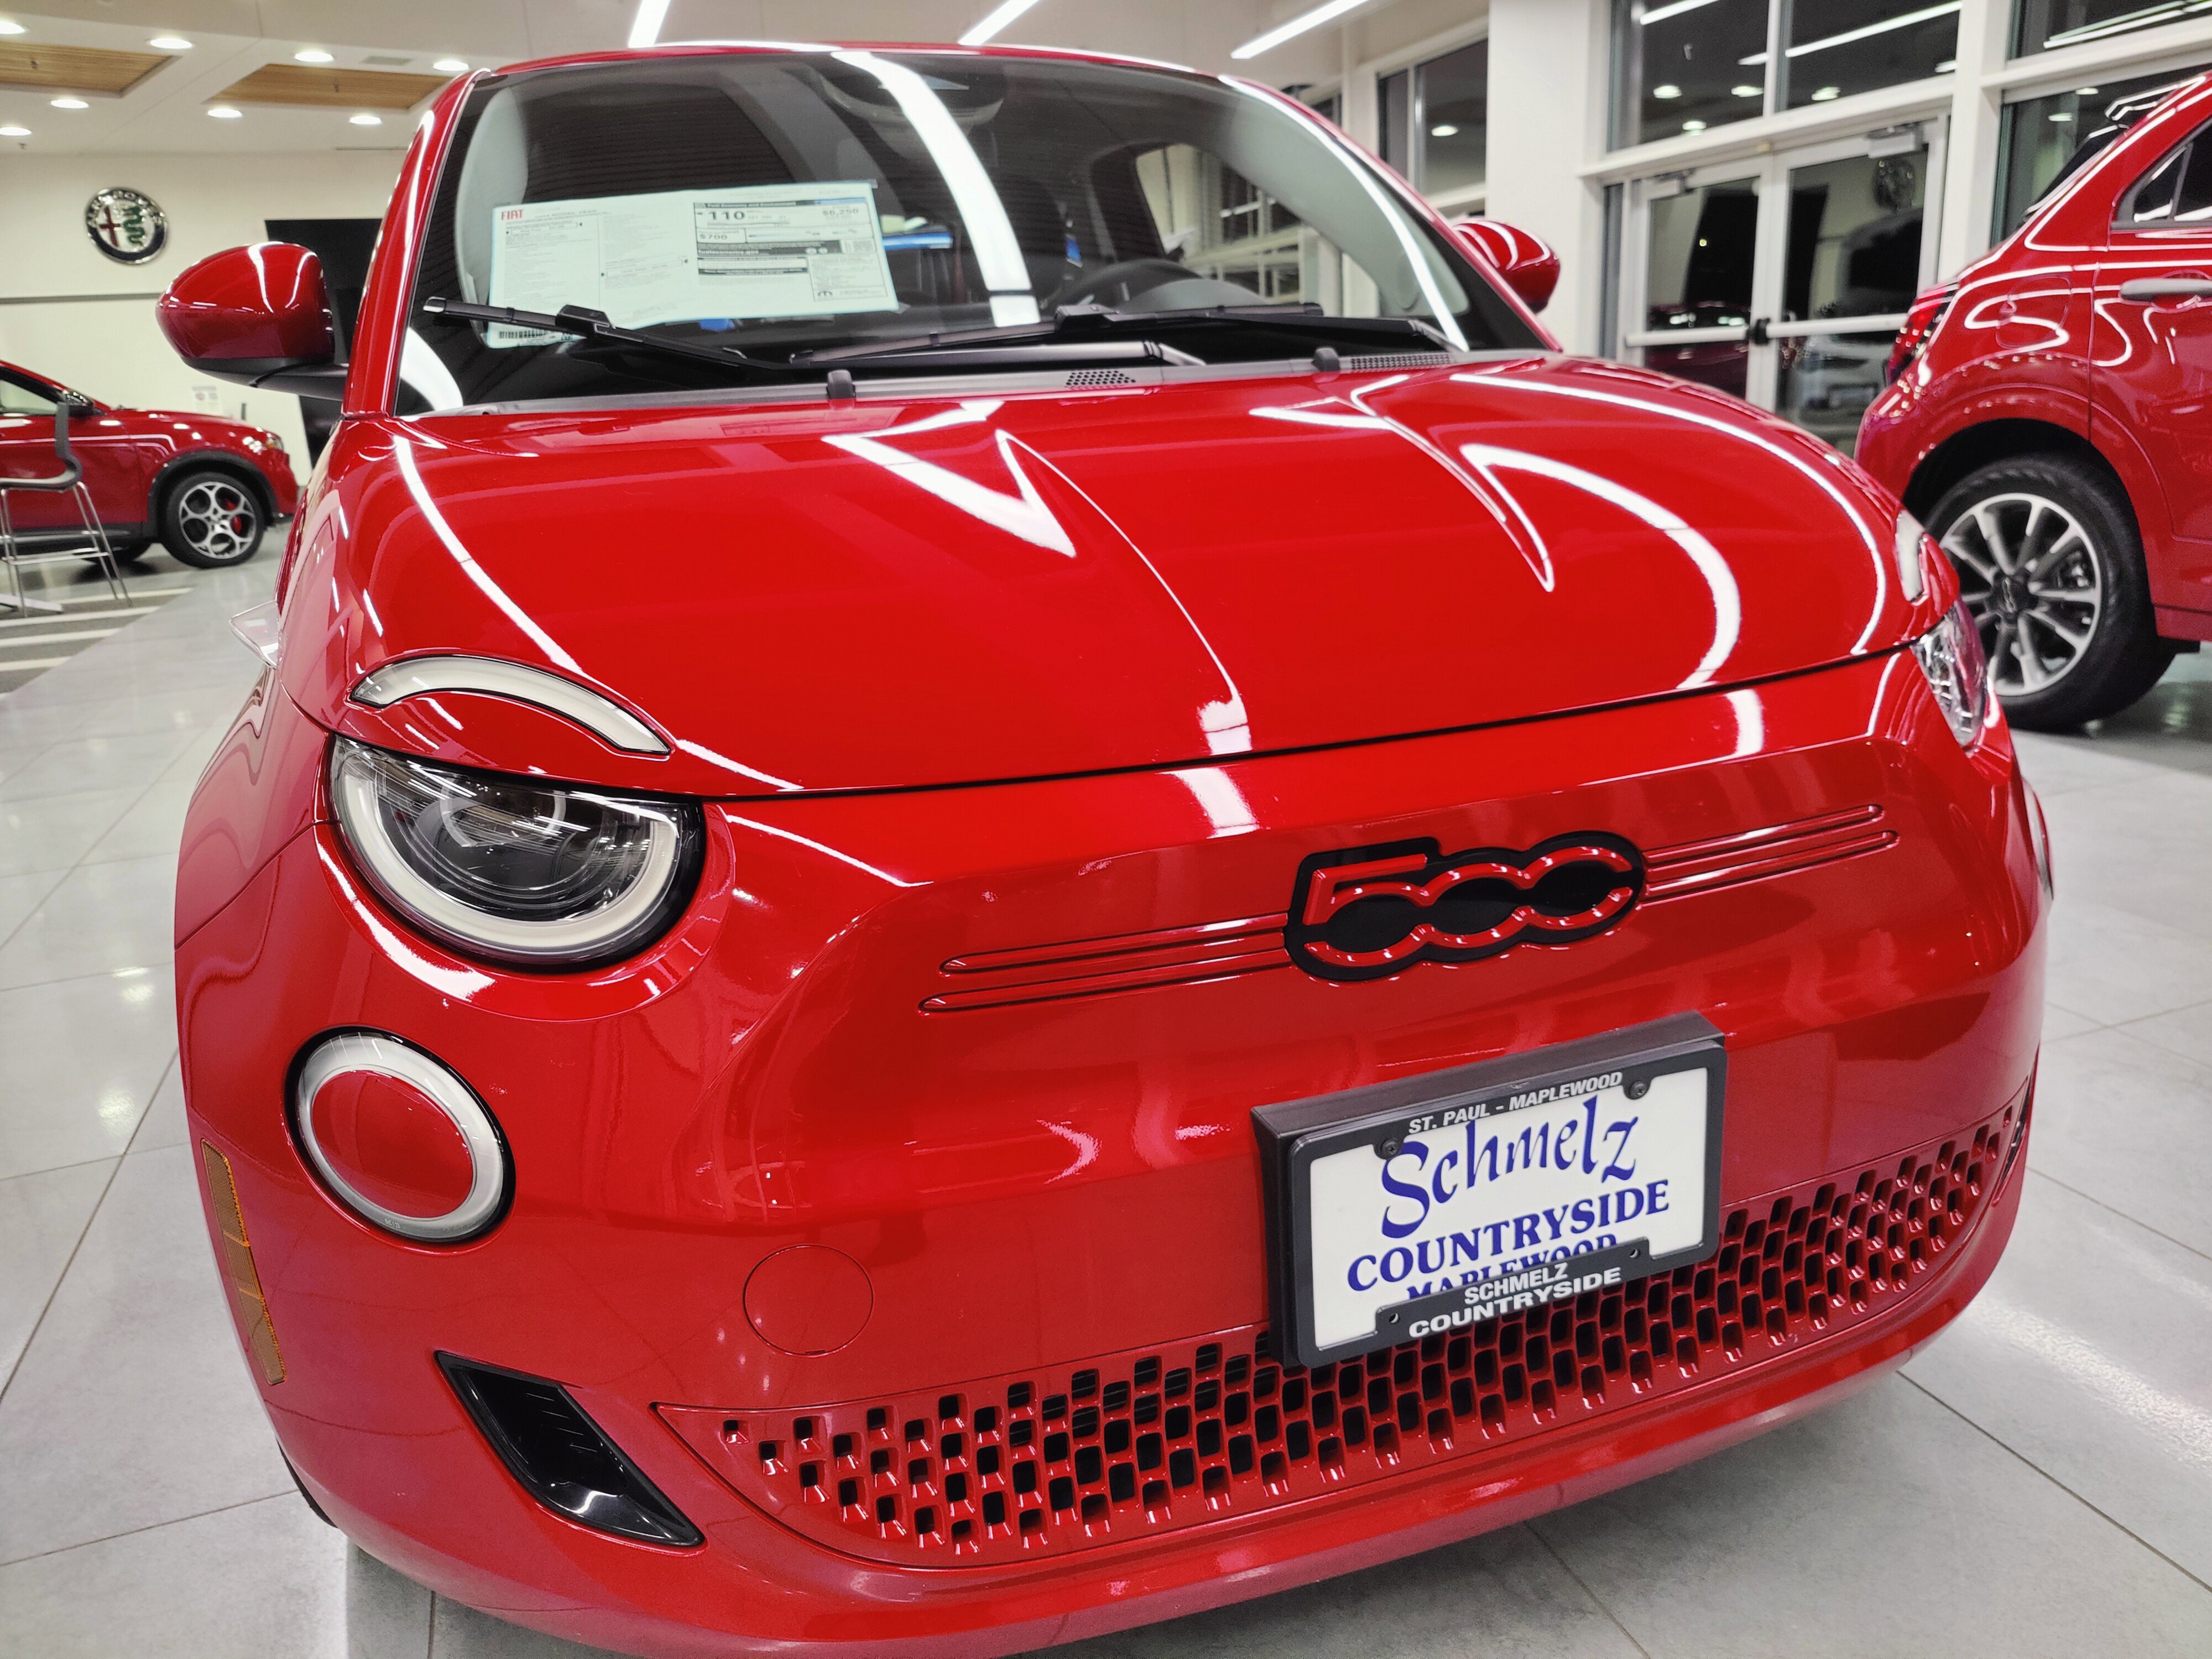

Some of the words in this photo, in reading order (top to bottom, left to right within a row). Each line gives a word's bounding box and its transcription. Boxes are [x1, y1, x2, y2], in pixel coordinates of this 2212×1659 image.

[501, 209, 524, 220] FIAT
[708, 211, 745, 221] 110
[1302, 846, 1634, 968] 500
[1408, 1117, 1437, 1134] ST.
[1443, 1104, 1491, 1127] PAUL
[1508, 1071, 1623, 1111] MAPLEWOOD
[1381, 1094, 1639, 1239] Schmelz
[1347, 1178, 1670, 1292] COUNTRYSIDE
[1408, 1266, 1621, 1338] COUNTRYSIDE
[1464, 1262, 1568, 1305] SCHMELZ
